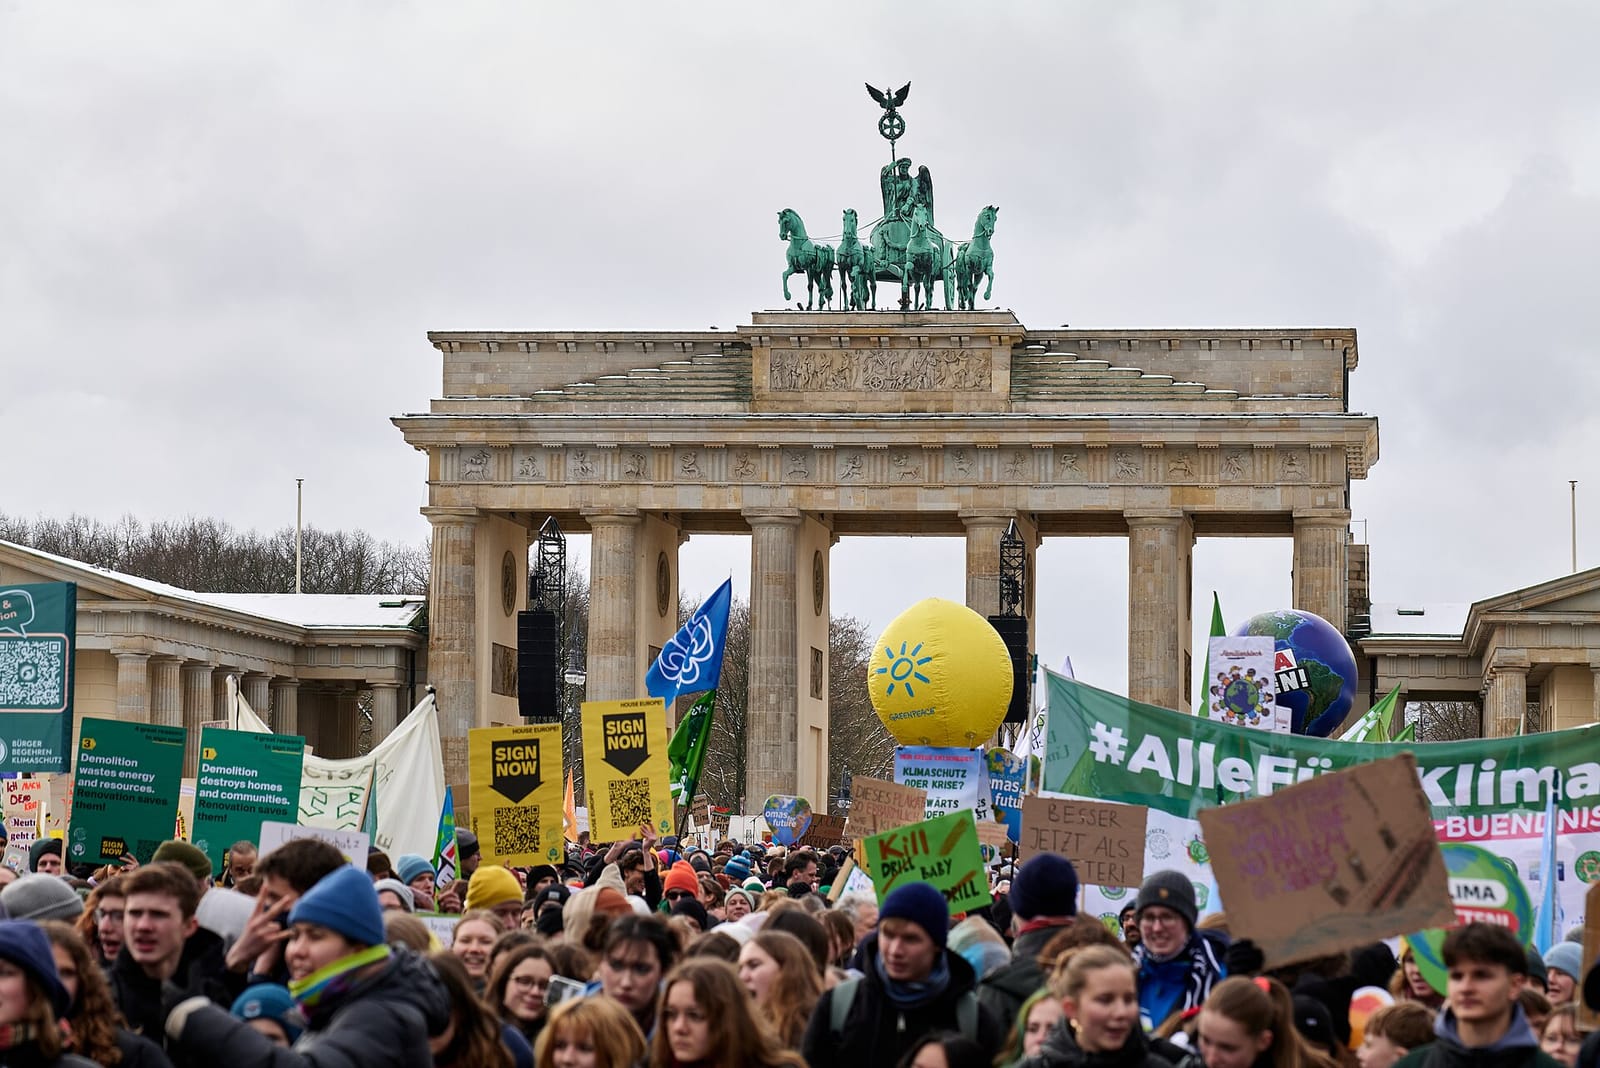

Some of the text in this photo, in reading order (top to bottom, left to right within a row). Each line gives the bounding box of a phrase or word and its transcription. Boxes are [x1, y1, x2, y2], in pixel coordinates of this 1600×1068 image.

[889, 706, 936, 720] GREENPEACE
[606, 720, 644, 735] SIGN
[12, 739, 42, 748] BÜRGER
[84, 740, 91, 748] 3
[608, 734, 644, 750] NOW
[12, 756, 63, 764] KLIMASCHUTZ
[81, 753, 138, 768] Demolition
[495, 746, 537, 761] SIGN
[80, 766, 156, 782] wastes energy
[202, 763, 258, 777] Demolition
[496, 761, 537, 777] NOW
[902, 767, 967, 778] KLIMASCHUTZ
[78, 778, 156, 794] and resources.
[200, 776, 282, 792] destroys homes
[905, 779, 964, 790] ODER KRISE?
[77, 788, 168, 806] Renovation saves
[199, 789, 290, 805] and communities.
[75, 800, 106, 812] them!
[198, 800, 288, 816] Renovation saves
[197, 812, 228, 822] them!
[765, 810, 788, 818] omas
[1048, 804, 1122, 828] BESSER
[772, 819, 796, 828] future
[10, 832, 28, 840] geht
[1029, 828, 1086, 852] JETZT
[1095, 836, 1130, 858] ALS
[102, 840, 124, 848] SIGN
[102, 847, 123, 856] NOW
[878, 830, 930, 860] Kill
[881, 857, 952, 880] DRILL BABY
[1449, 885, 1497, 900] IMA
